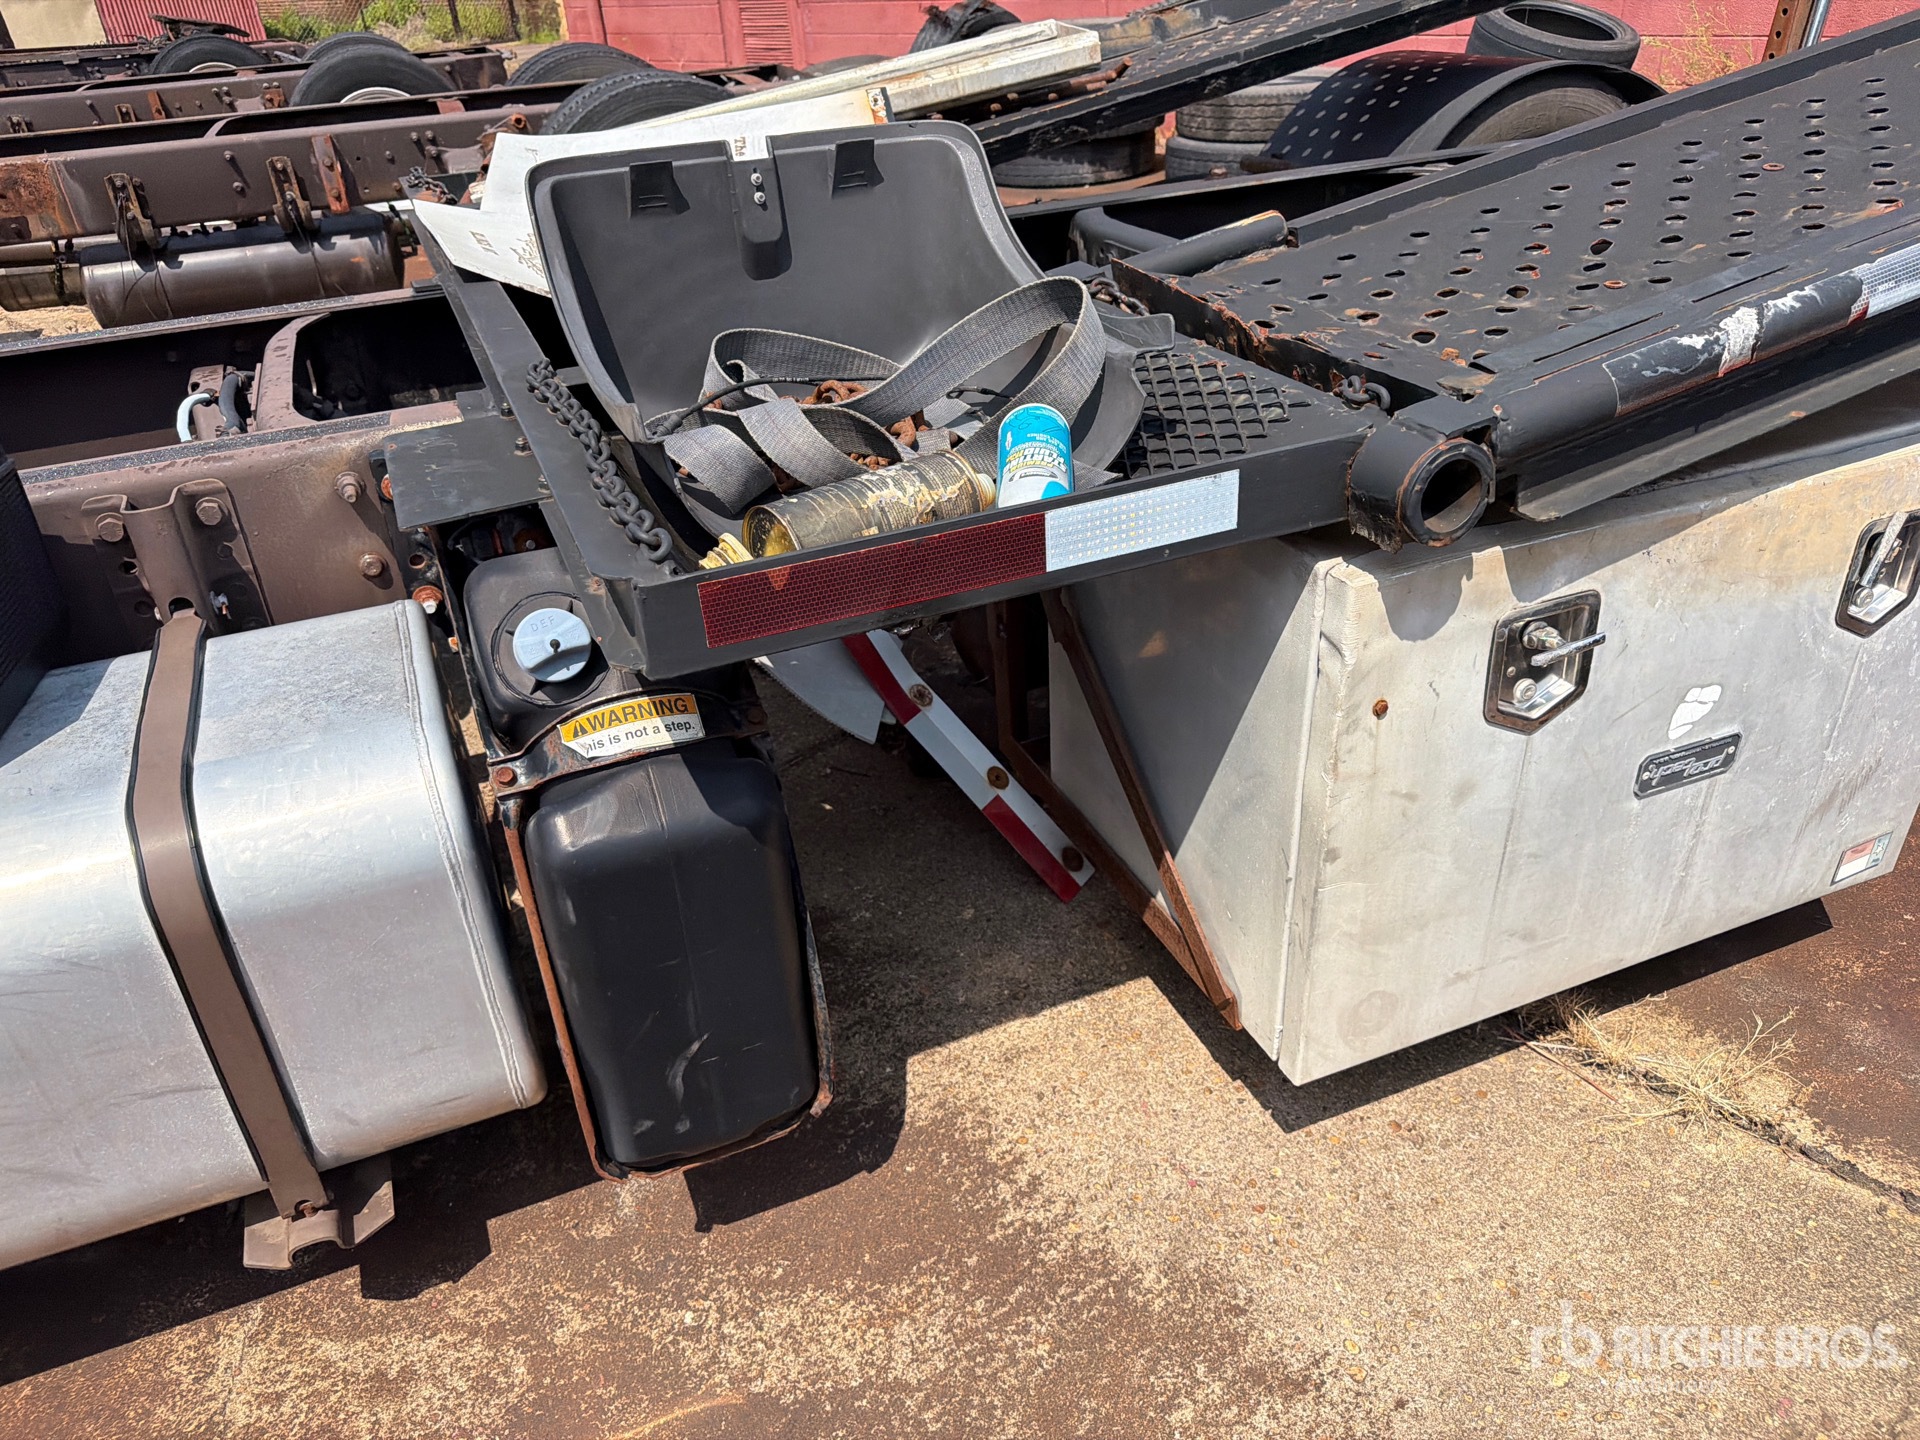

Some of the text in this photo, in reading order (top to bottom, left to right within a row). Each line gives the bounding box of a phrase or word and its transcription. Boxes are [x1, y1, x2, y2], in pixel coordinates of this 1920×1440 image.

[733, 136, 747, 157] The
[1003, 454, 1067, 475] STARTING
[1023, 447, 1065, 463] FLUID
[530, 615, 555, 632] DEF
[586, 697, 689, 732] WARNING
[608, 734, 621, 746] is
[625, 726, 650, 741] not
[653, 724, 662, 735] a
[665, 721, 696, 734] step.
